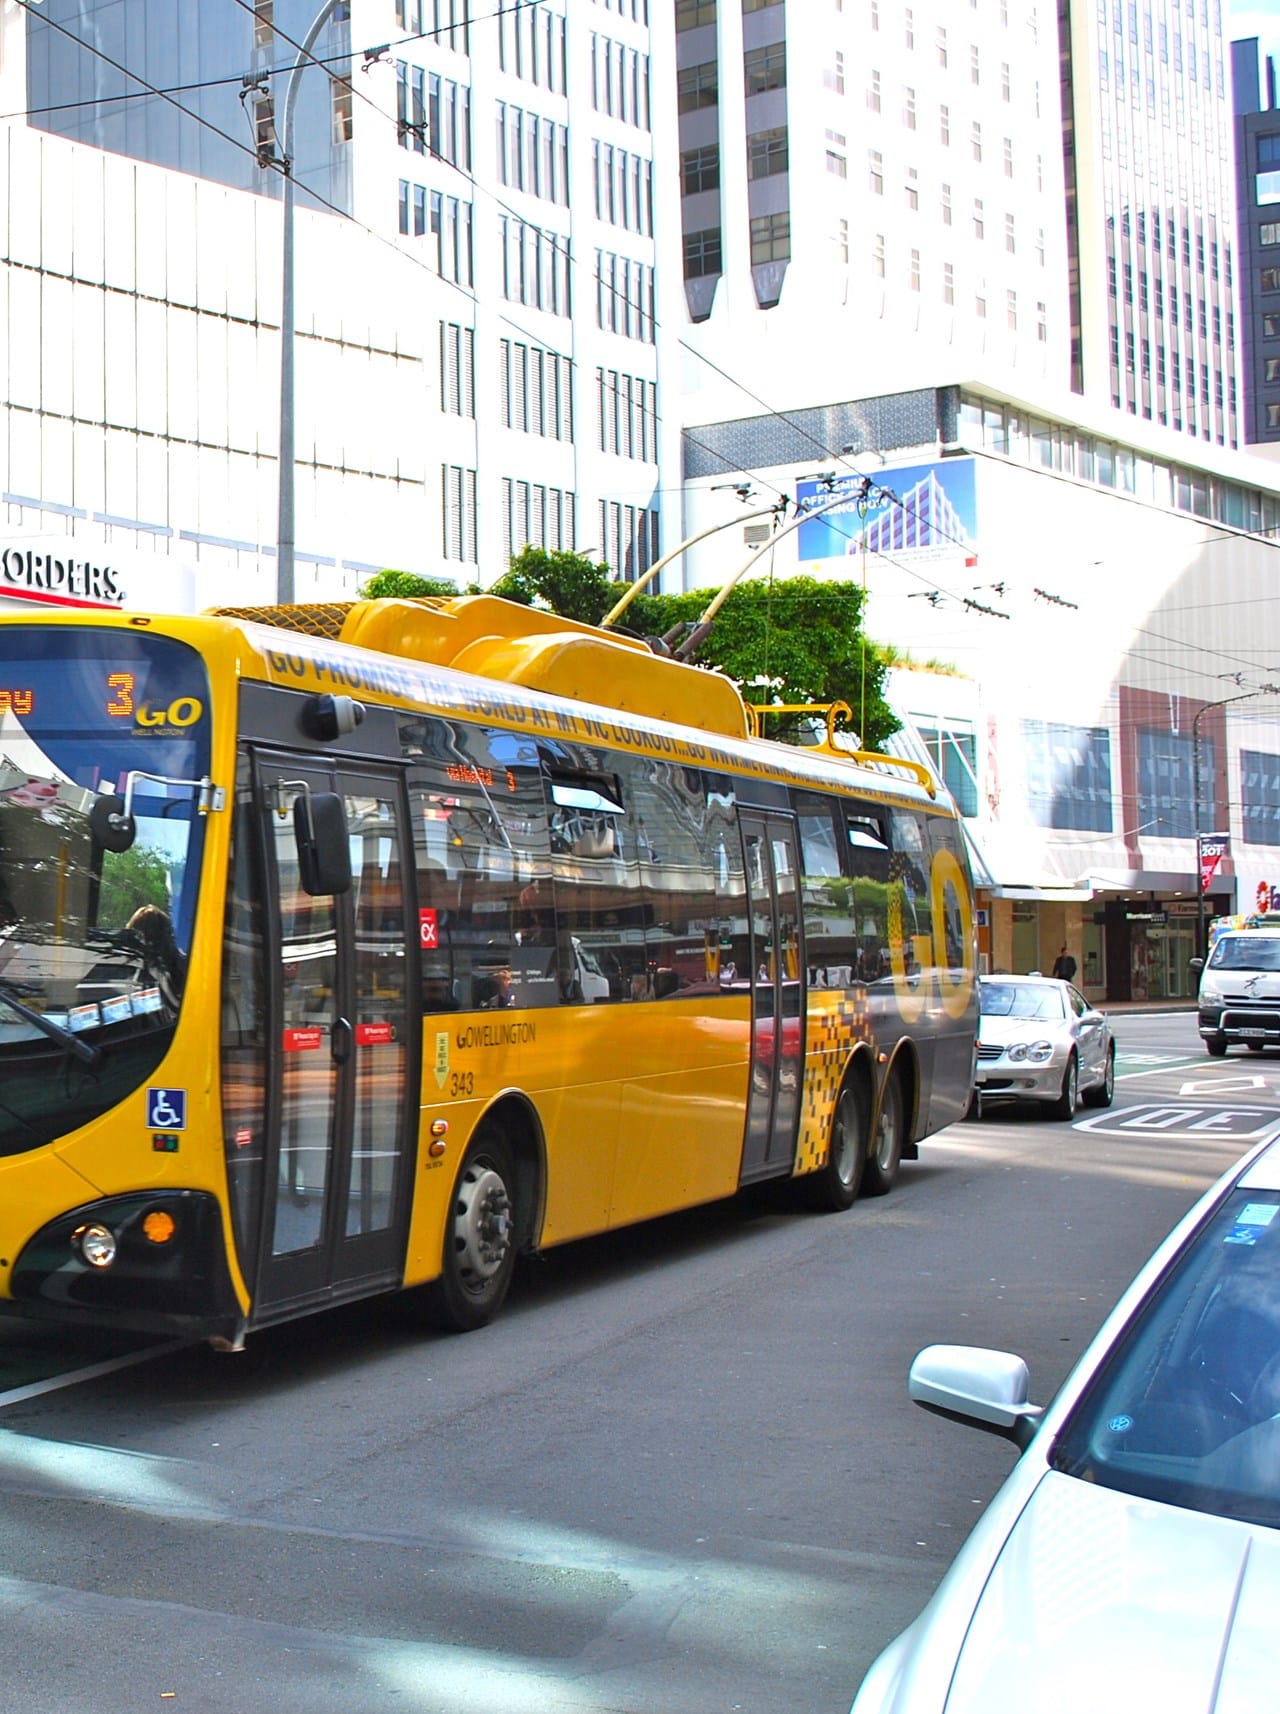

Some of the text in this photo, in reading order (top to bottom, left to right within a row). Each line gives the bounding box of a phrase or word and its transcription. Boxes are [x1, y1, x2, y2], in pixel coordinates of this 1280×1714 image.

[106, 672, 135, 717] 3
[135, 696, 203, 728] GO
[269, 649, 306, 678] GO
[313, 656, 414, 699] PROMISE
[458, 685, 527, 723] WORLD
[532, 701, 551, 729] AT
[581, 710, 609, 741] VIC
[450, 1071, 475, 1097] 343
